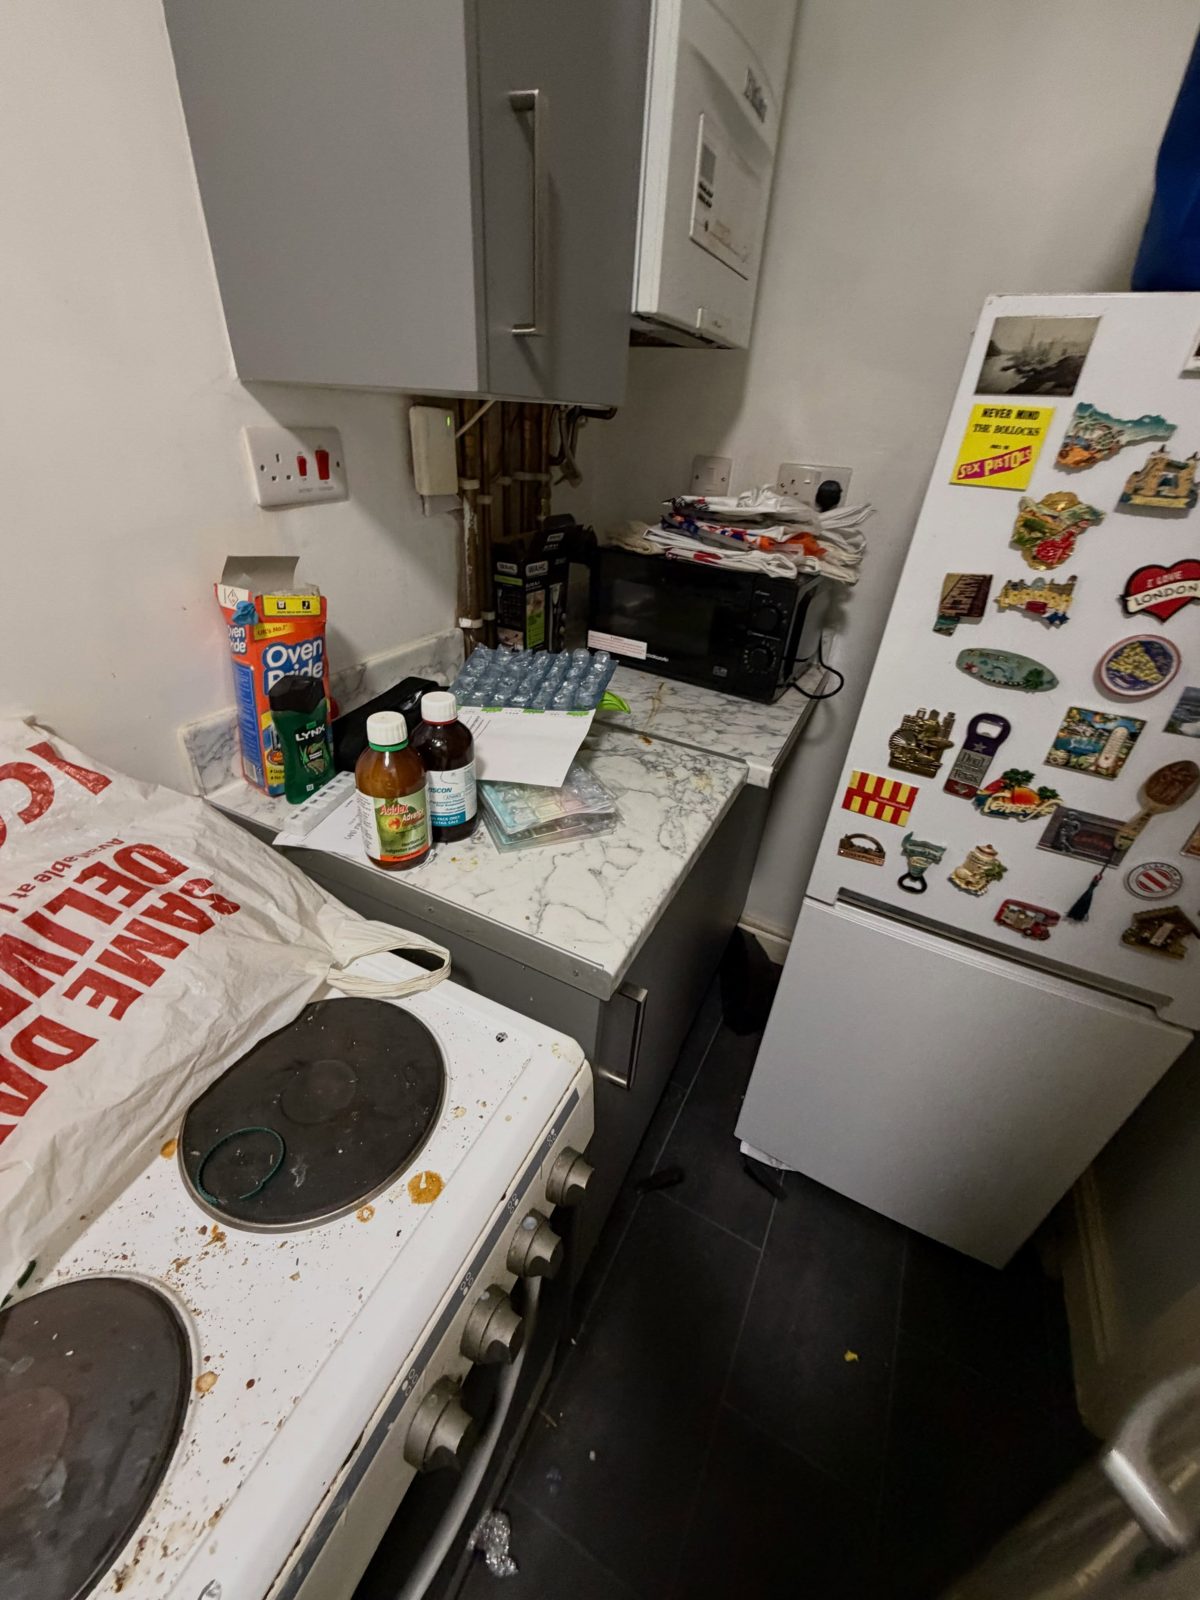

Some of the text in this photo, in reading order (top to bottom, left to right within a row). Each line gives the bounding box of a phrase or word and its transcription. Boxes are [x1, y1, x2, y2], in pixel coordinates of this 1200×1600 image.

[981, 407, 1040, 420] NEVER MIND
[973, 423, 1041, 437] THE BOLLOCKS
[1134, 582, 1199, 606] LONDON
[266, 638, 323, 668] Oven
[268, 659, 323, 691] Pide
[295, 723, 326, 742] LYNX
[0, 877, 242, 1147] SAME DA
